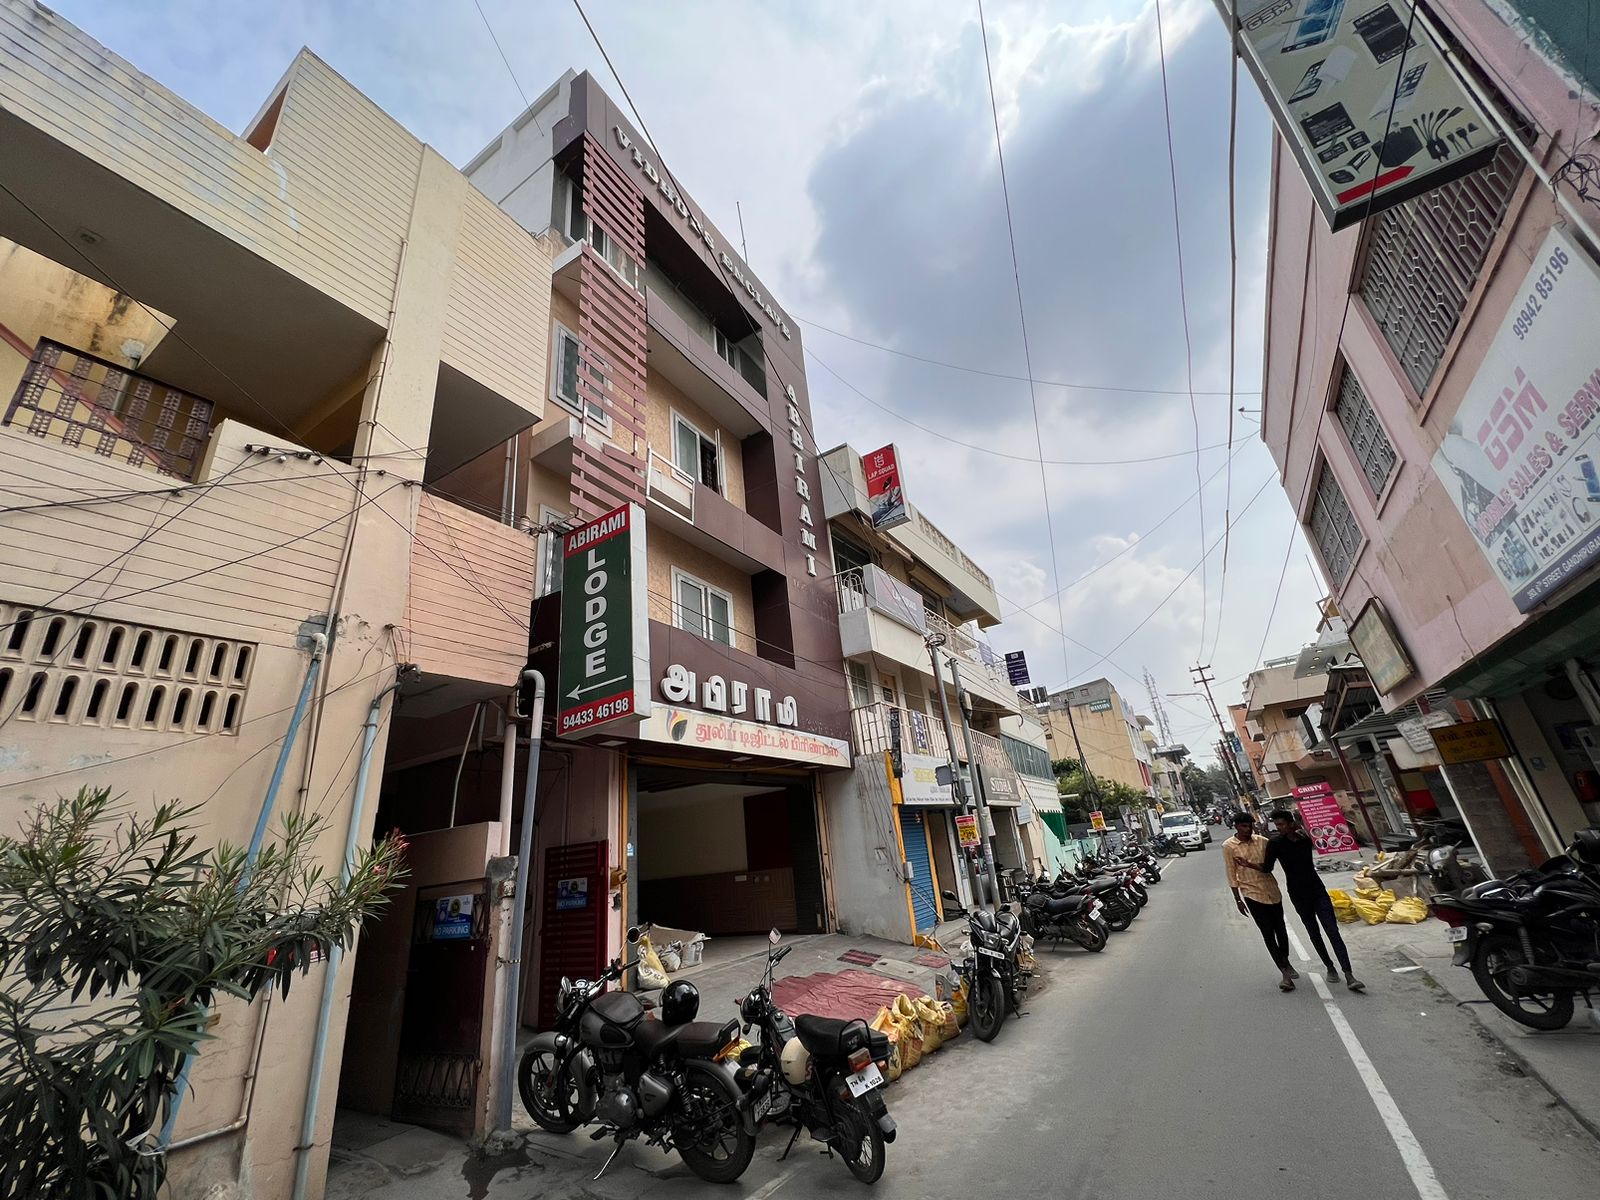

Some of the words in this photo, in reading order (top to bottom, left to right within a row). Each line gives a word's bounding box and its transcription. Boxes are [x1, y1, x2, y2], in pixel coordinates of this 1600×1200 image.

[1247, 0, 1292, 31] GSM
[1512, 294, 1542, 340] 99942
[1535, 246, 1568, 300] 85196
[1477, 366, 1548, 471] GSM
[784, 384, 817, 577] ABIRAMI
[1508, 444, 1553, 499] SALES
[1545, 431, 1566, 454] &
[568, 511, 626, 551] ABIRAMI
[583, 549, 608, 678] LODGE
[563, 710, 594, 729] 94433
[596, 697, 629, 719] 46198
[660, 664, 798, 727] அபிராமி
[1297, 784, 1323, 794] CRISTY
[442, 924, 469, 936] PARKING
